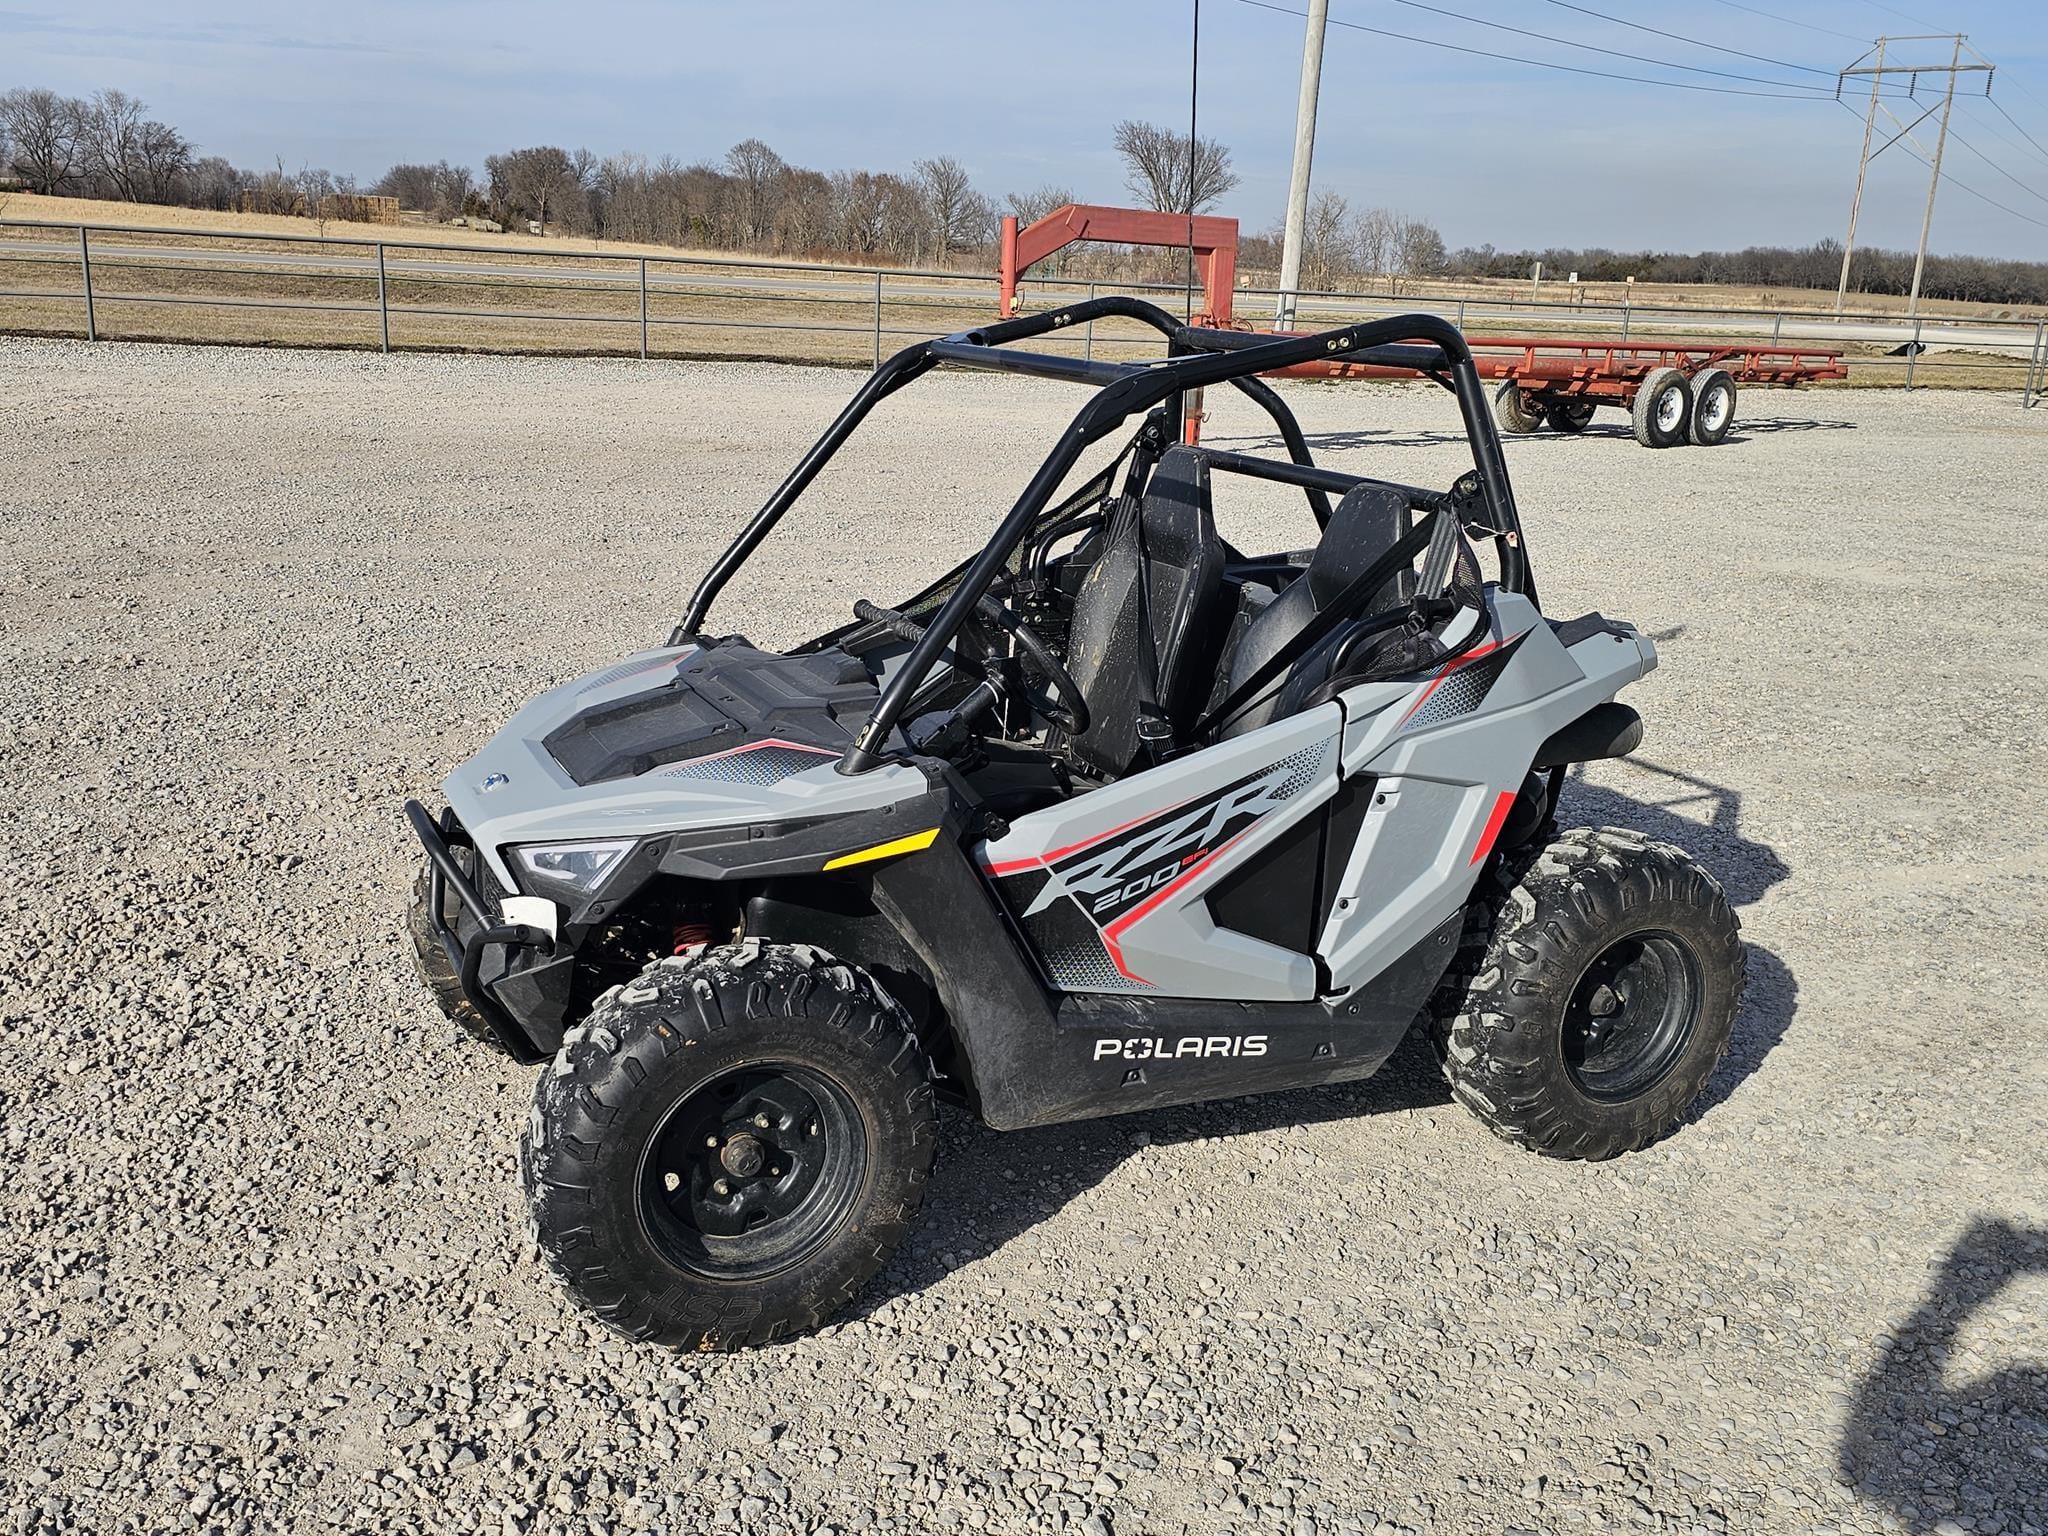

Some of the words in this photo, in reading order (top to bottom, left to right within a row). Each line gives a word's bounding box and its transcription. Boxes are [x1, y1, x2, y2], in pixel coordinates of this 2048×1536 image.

[1021, 768, 1295, 918] RZR
[1093, 860, 1181, 914] 200
[1093, 1035, 1268, 1061] POLARIS
